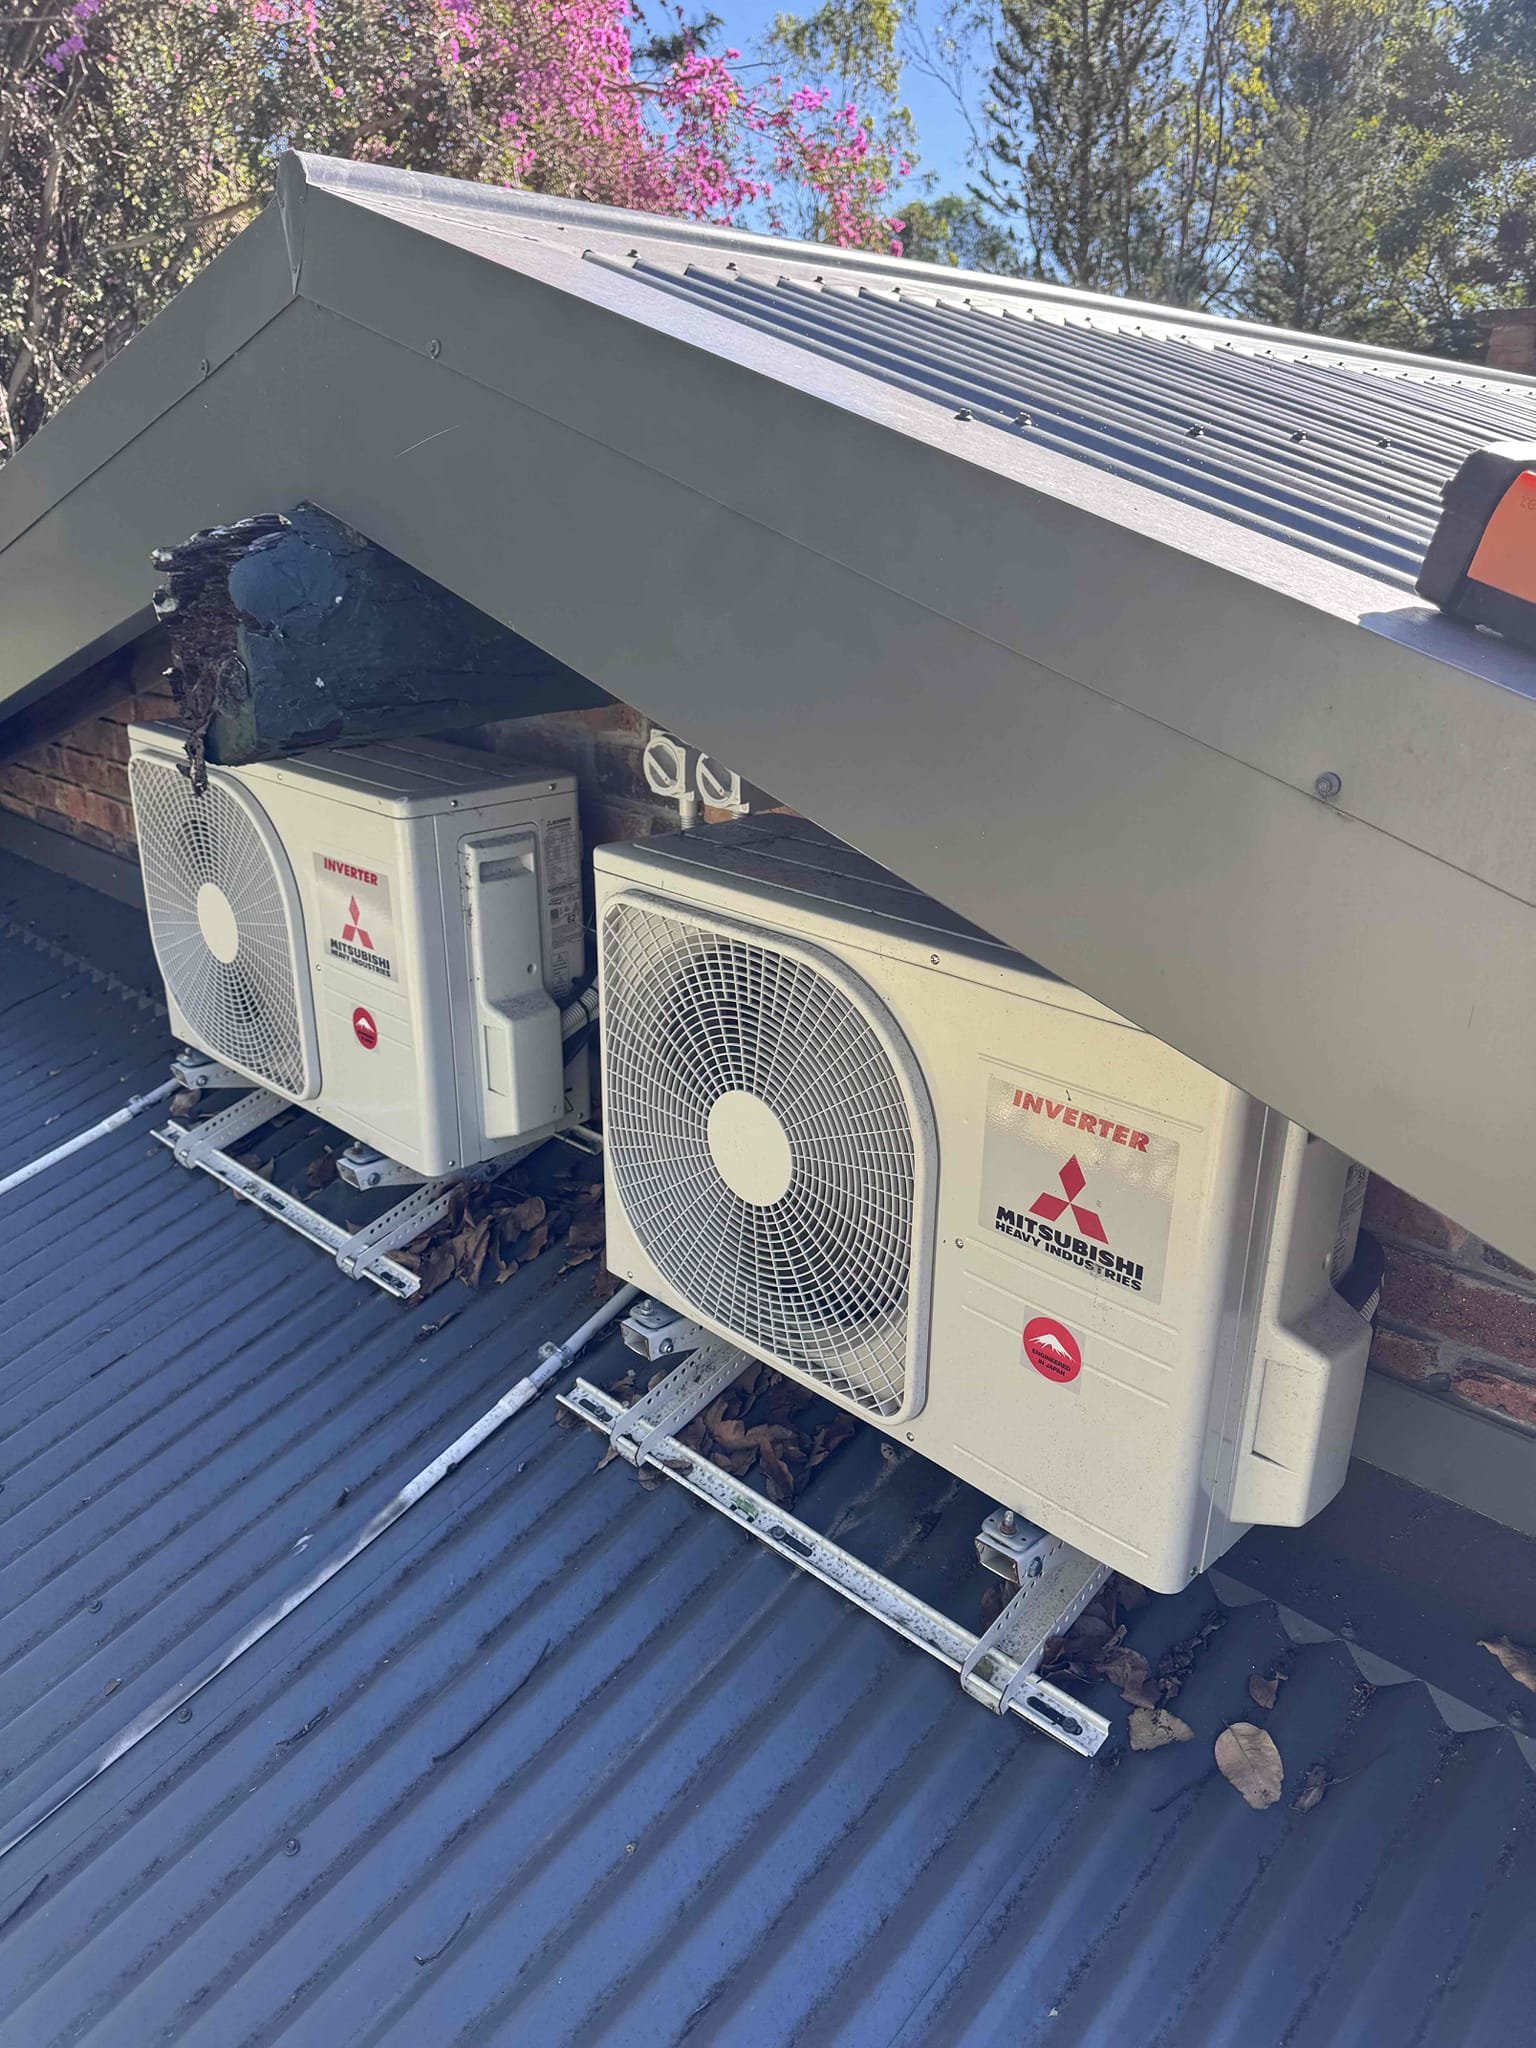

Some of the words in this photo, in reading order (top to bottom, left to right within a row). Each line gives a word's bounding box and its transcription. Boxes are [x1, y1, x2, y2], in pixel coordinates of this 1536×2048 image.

[323, 857, 378, 886] INVERTER
[330, 938, 391, 970] MITSUBISHI
[331, 949, 350, 963] HEAVY
[351, 956, 391, 977] INDUSTRIES
[1012, 1088, 1151, 1153] INVERTER
[995, 1205, 1144, 1280] MITSUBISHI
[995, 1220, 1041, 1248] HEAVY
[1044, 1242, 1143, 1292] INDUSTRIES
[1031, 1348, 1071, 1372] ENGINEERED
[1037, 1358, 1045, 1366] IN
[1045, 1363, 1066, 1377] JAPAN
